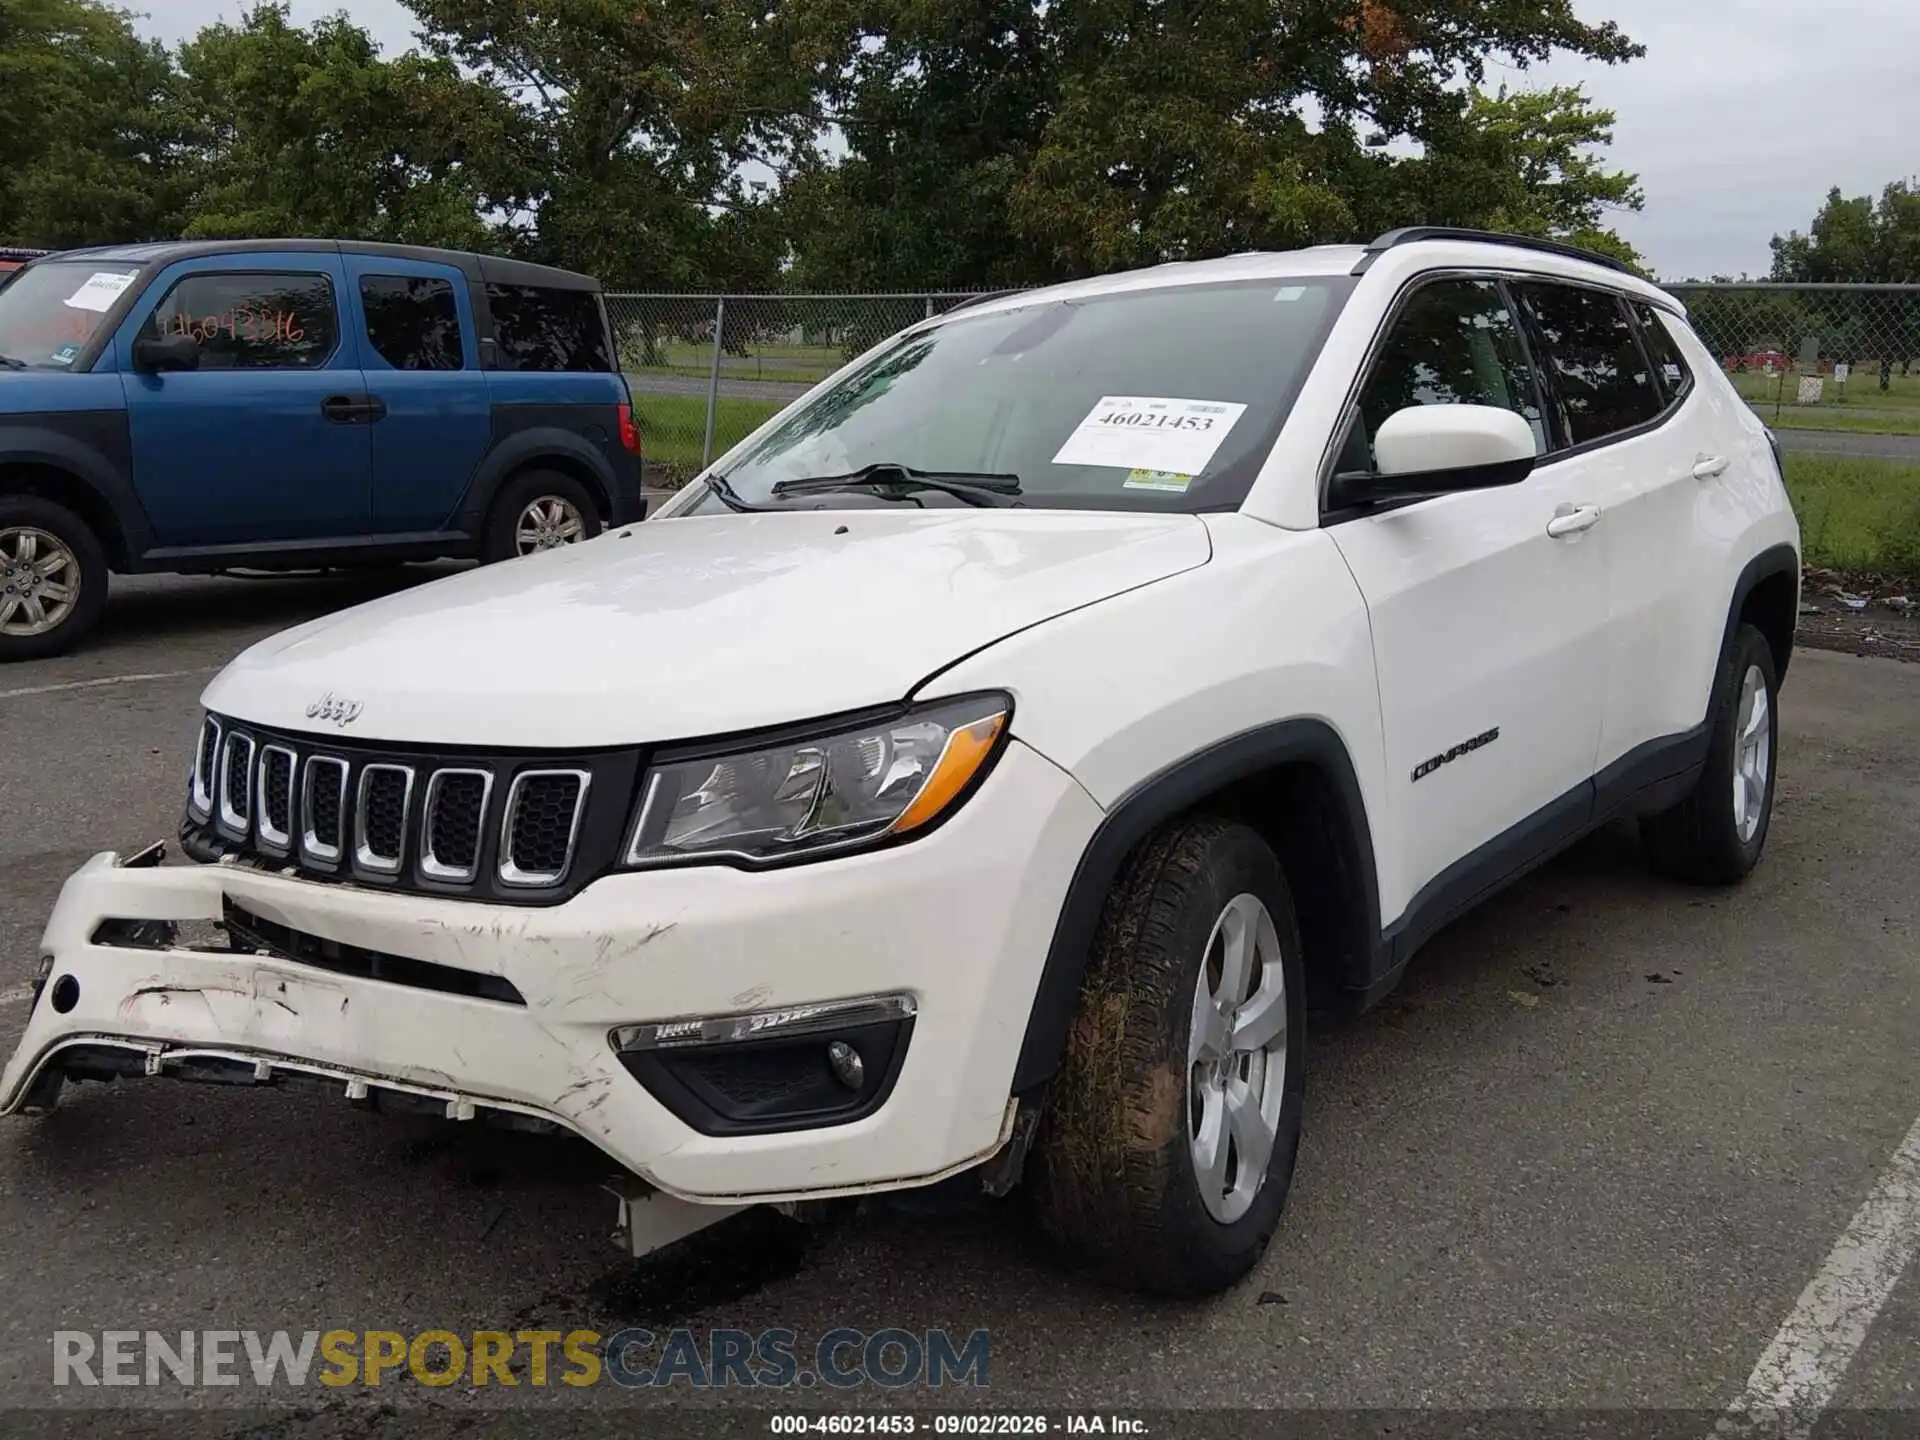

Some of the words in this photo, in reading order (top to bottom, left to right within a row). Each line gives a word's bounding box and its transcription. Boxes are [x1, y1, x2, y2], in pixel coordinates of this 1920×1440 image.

[1097, 411, 1215, 431] 46021453
[305, 688, 365, 728] Jeep
[1410, 725, 1500, 783] COMPASS
